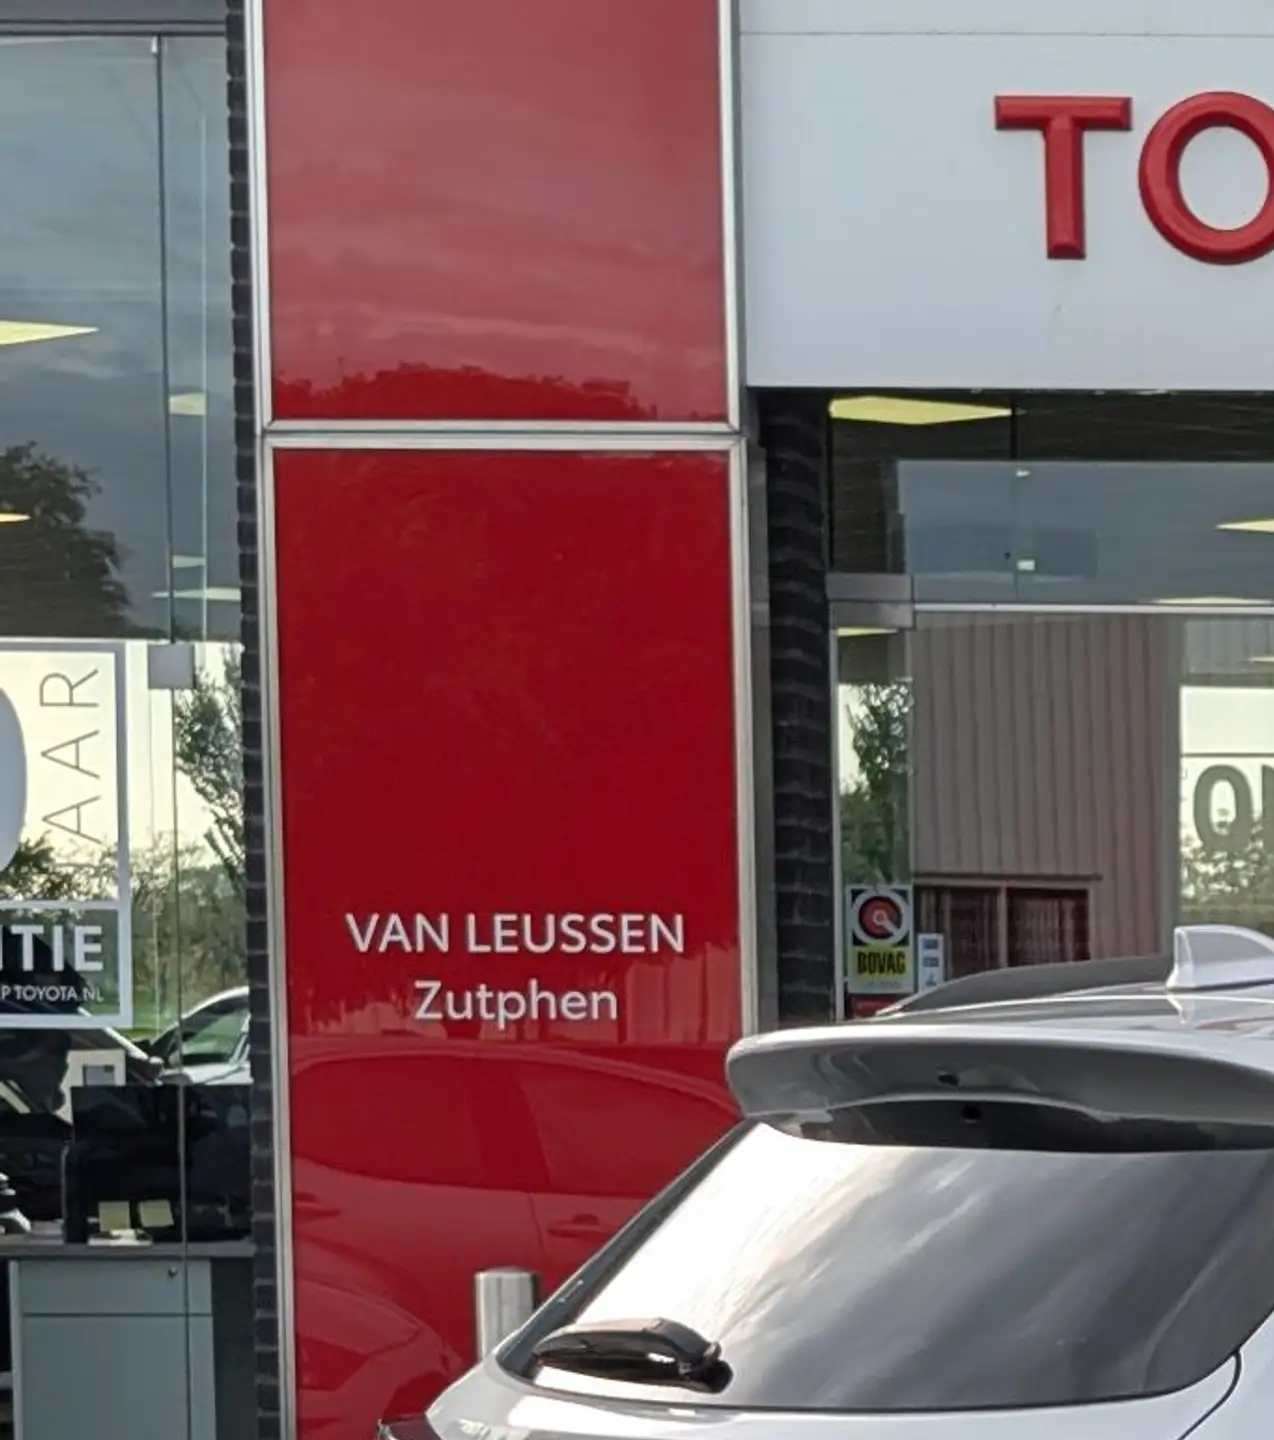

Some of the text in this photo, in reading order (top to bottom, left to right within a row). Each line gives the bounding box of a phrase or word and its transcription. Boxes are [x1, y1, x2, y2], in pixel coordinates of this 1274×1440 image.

[0, 924, 104, 972] TIE
[345, 912, 685, 953] VAN LEUSSEN
[857, 951, 906, 975] BOVAG
[414, 978, 618, 1031] Zutphen
